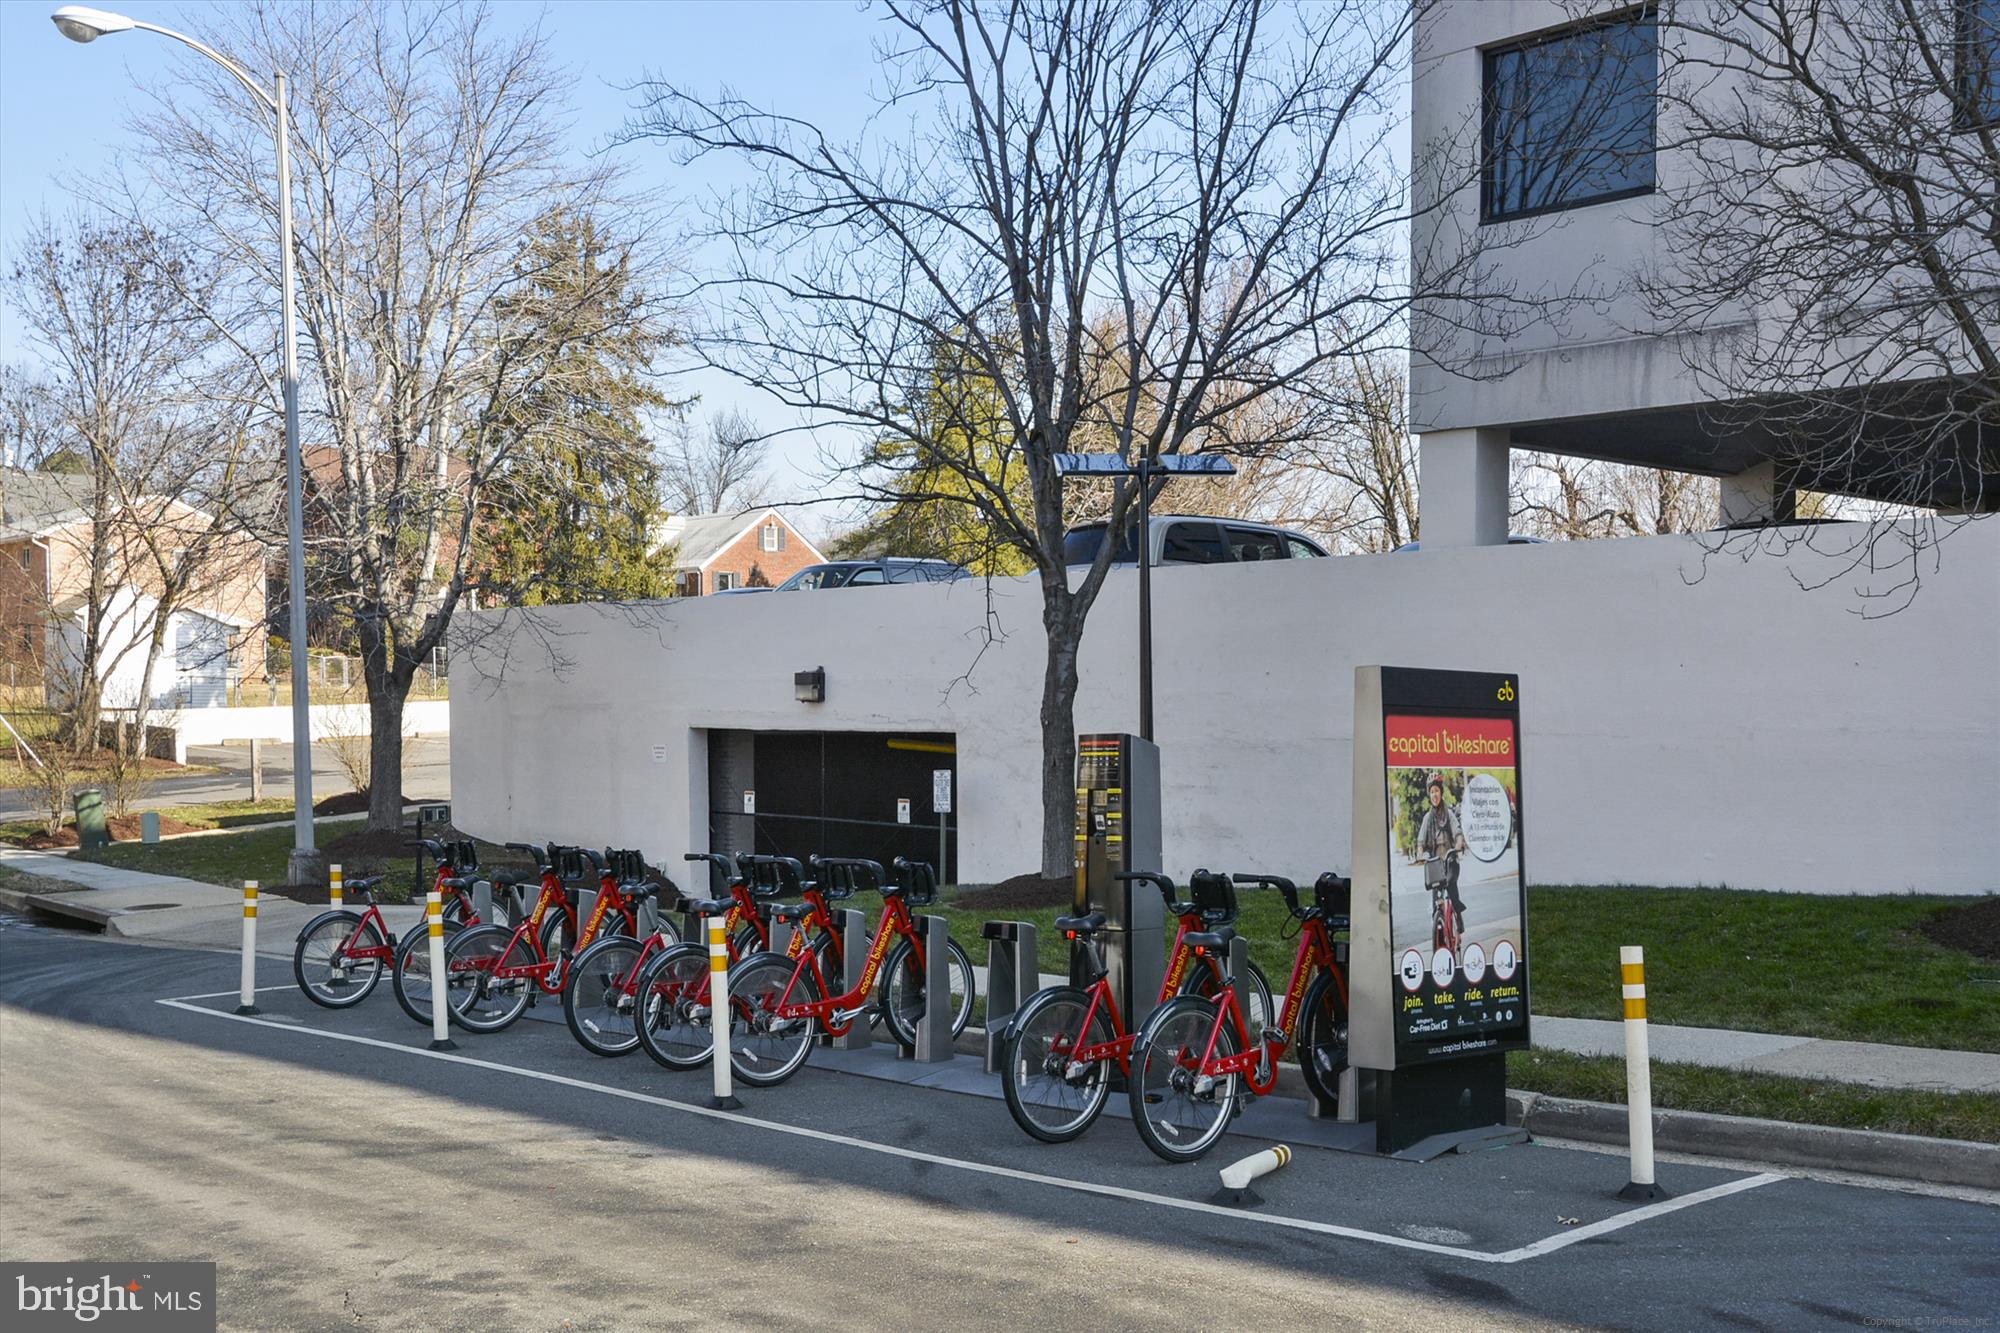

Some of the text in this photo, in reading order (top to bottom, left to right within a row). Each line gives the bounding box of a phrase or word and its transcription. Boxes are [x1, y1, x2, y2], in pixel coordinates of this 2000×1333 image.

[1388, 728, 1510, 758] capital bikeshare
[860, 917, 895, 995] capital bikeshare
[1291, 944, 1315, 998] bikeshare
[1433, 991, 1456, 1004] take.
[1464, 987, 1484, 1001] ride.
[1490, 985, 1520, 998] return.
[1403, 996, 1424, 1012] join.
